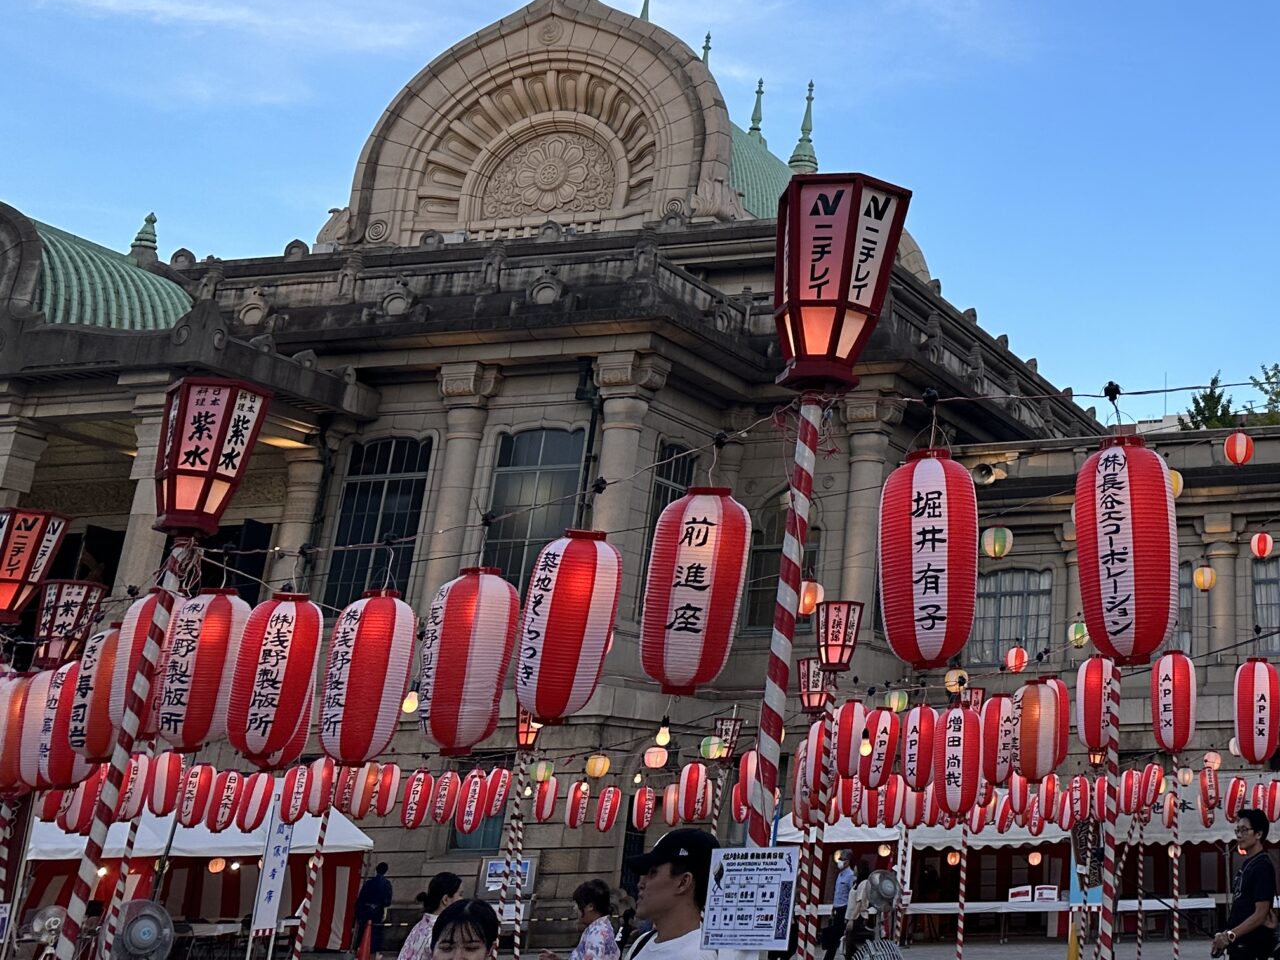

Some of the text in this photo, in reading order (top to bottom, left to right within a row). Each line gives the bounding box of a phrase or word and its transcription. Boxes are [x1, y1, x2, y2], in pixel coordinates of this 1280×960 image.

[809, 224, 833, 299] ニチレイ
[852, 226, 880, 301] ニチレイ
[180, 411, 216, 468] 紫水
[219, 414, 250, 471] 紫水
[6, 535, 28, 576] ニチレイ
[29, 539, 53, 580] ニチレイ
[664, 515, 718, 634] 前進座
[910, 490, 947, 630] 堀井有子
[53, 599, 78, 635] 紫水
[519, 551, 560, 687] 築地そらつき
[160, 603, 205, 735] (株)浅野製版所
[245, 613, 294, 737] (株)浅野製版所
[1162, 673, 1173, 728] APEX
[1256, 693, 1267, 737] APEX
[872, 726, 889, 774] APEX
[908, 726, 919, 776] APEX
[946, 716, 963, 788] 増田尚哉
[1001, 717, 1012, 764] APEX
[182, 771, 197, 817] 日刊スポーツ
[217, 775, 237, 827] 日刊スポーツ
